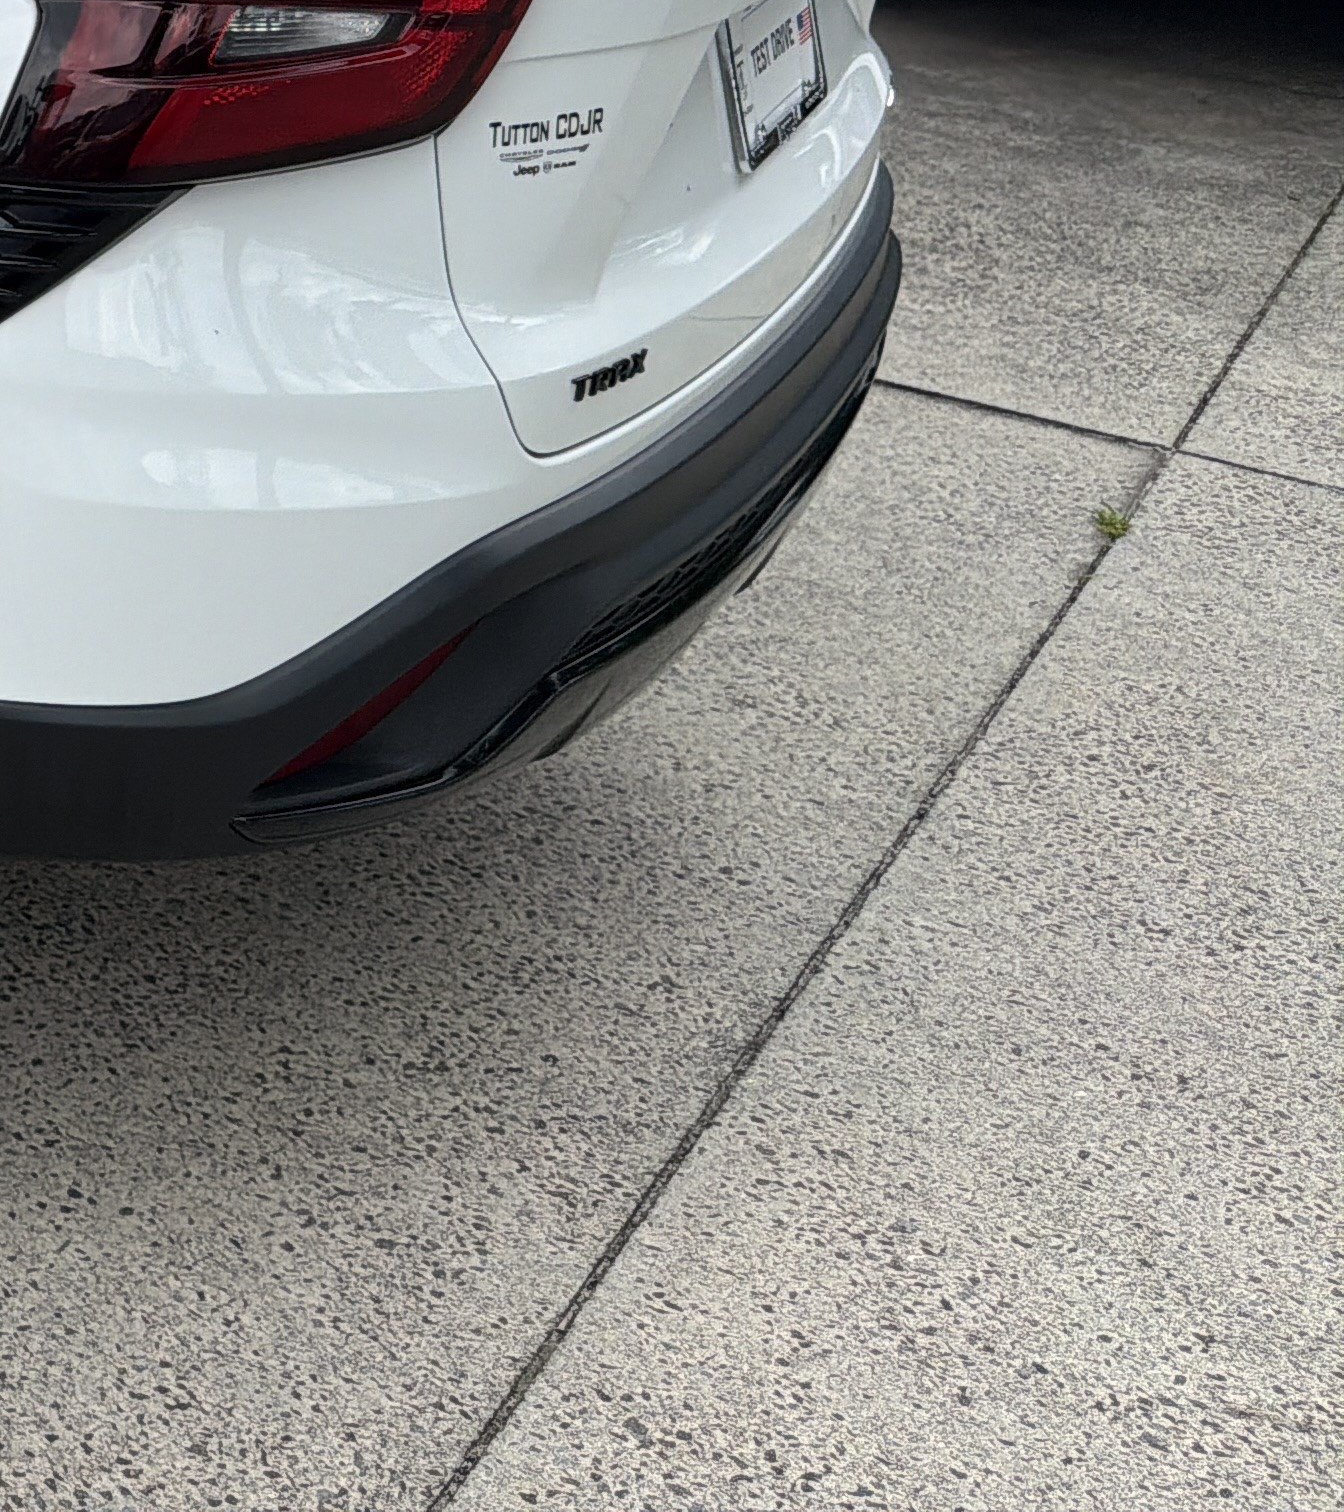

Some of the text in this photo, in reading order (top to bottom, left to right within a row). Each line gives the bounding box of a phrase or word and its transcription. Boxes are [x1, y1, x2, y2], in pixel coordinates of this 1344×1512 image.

[750, 18, 795, 77] TEST DRIVE
[489, 107, 603, 148] TUTTON CDJR
[513, 165, 540, 176] Jeep
[571, 348, 649, 402] TRAX
